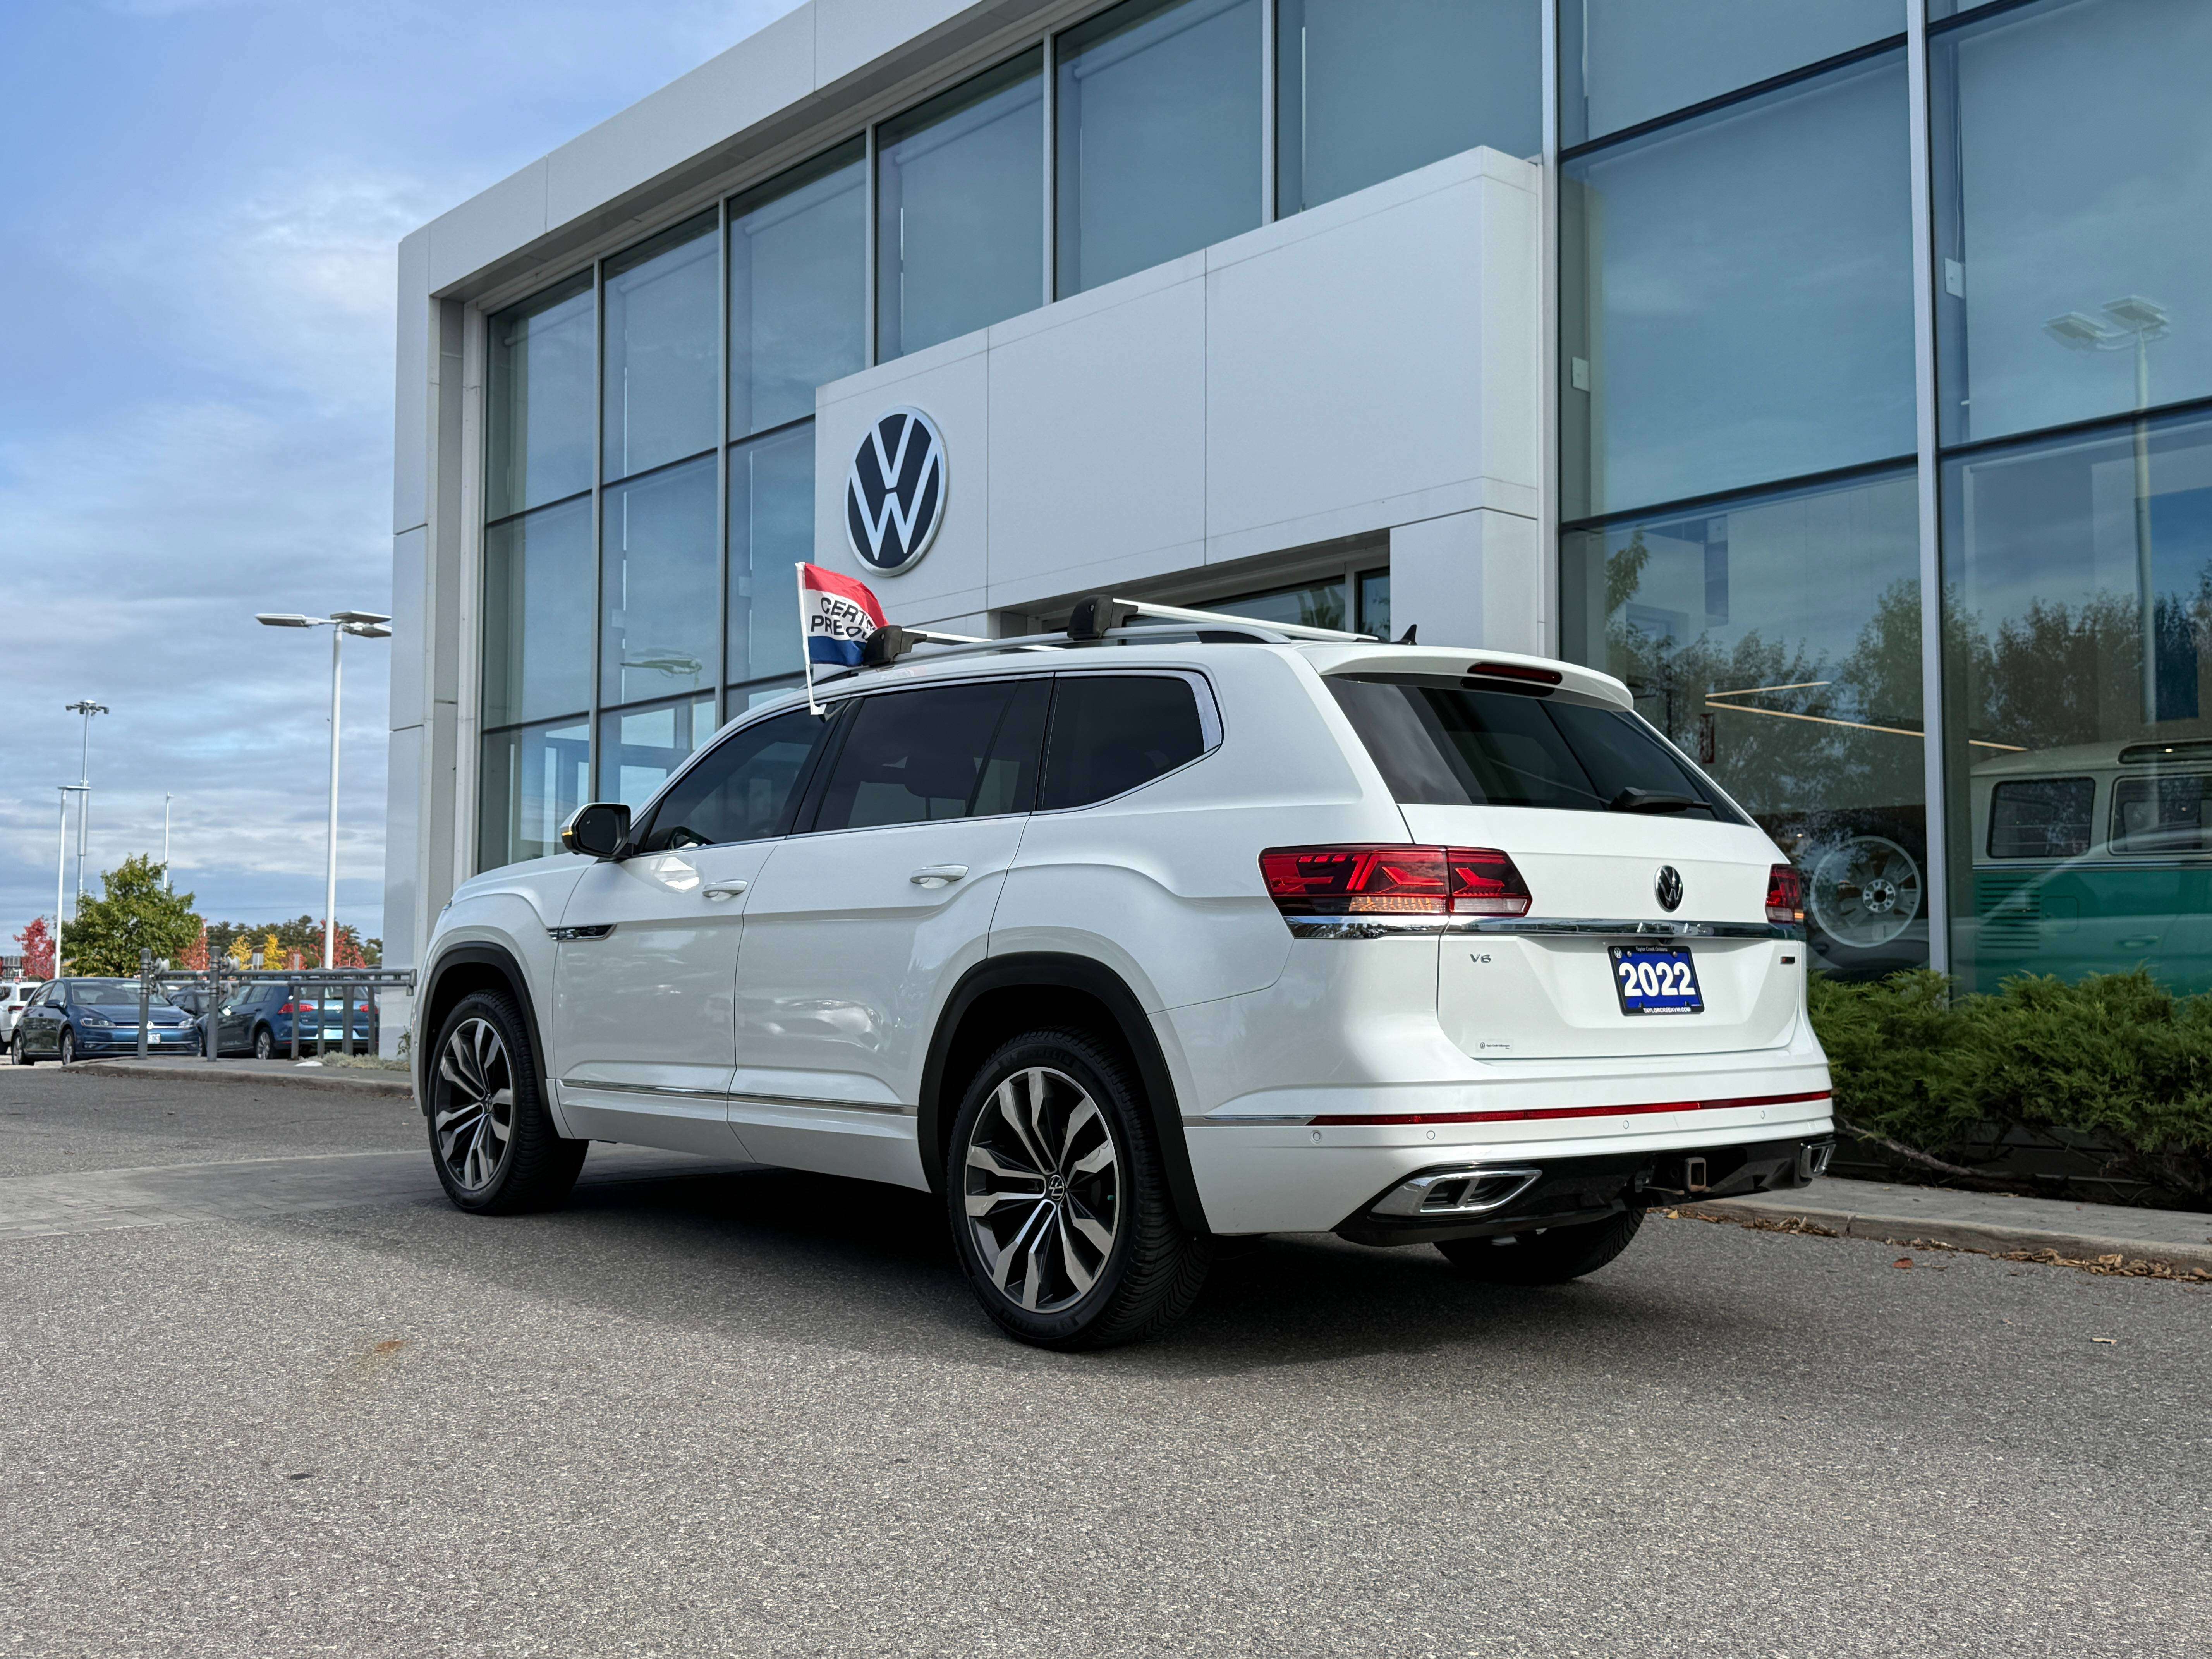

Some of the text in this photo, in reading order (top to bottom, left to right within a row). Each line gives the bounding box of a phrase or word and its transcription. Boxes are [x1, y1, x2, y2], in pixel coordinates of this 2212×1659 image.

[847, 410, 942, 562] VW
[1655, 866, 1683, 911] VW
[1470, 954, 1491, 963] V6
[1619, 962, 1697, 996] 2022
